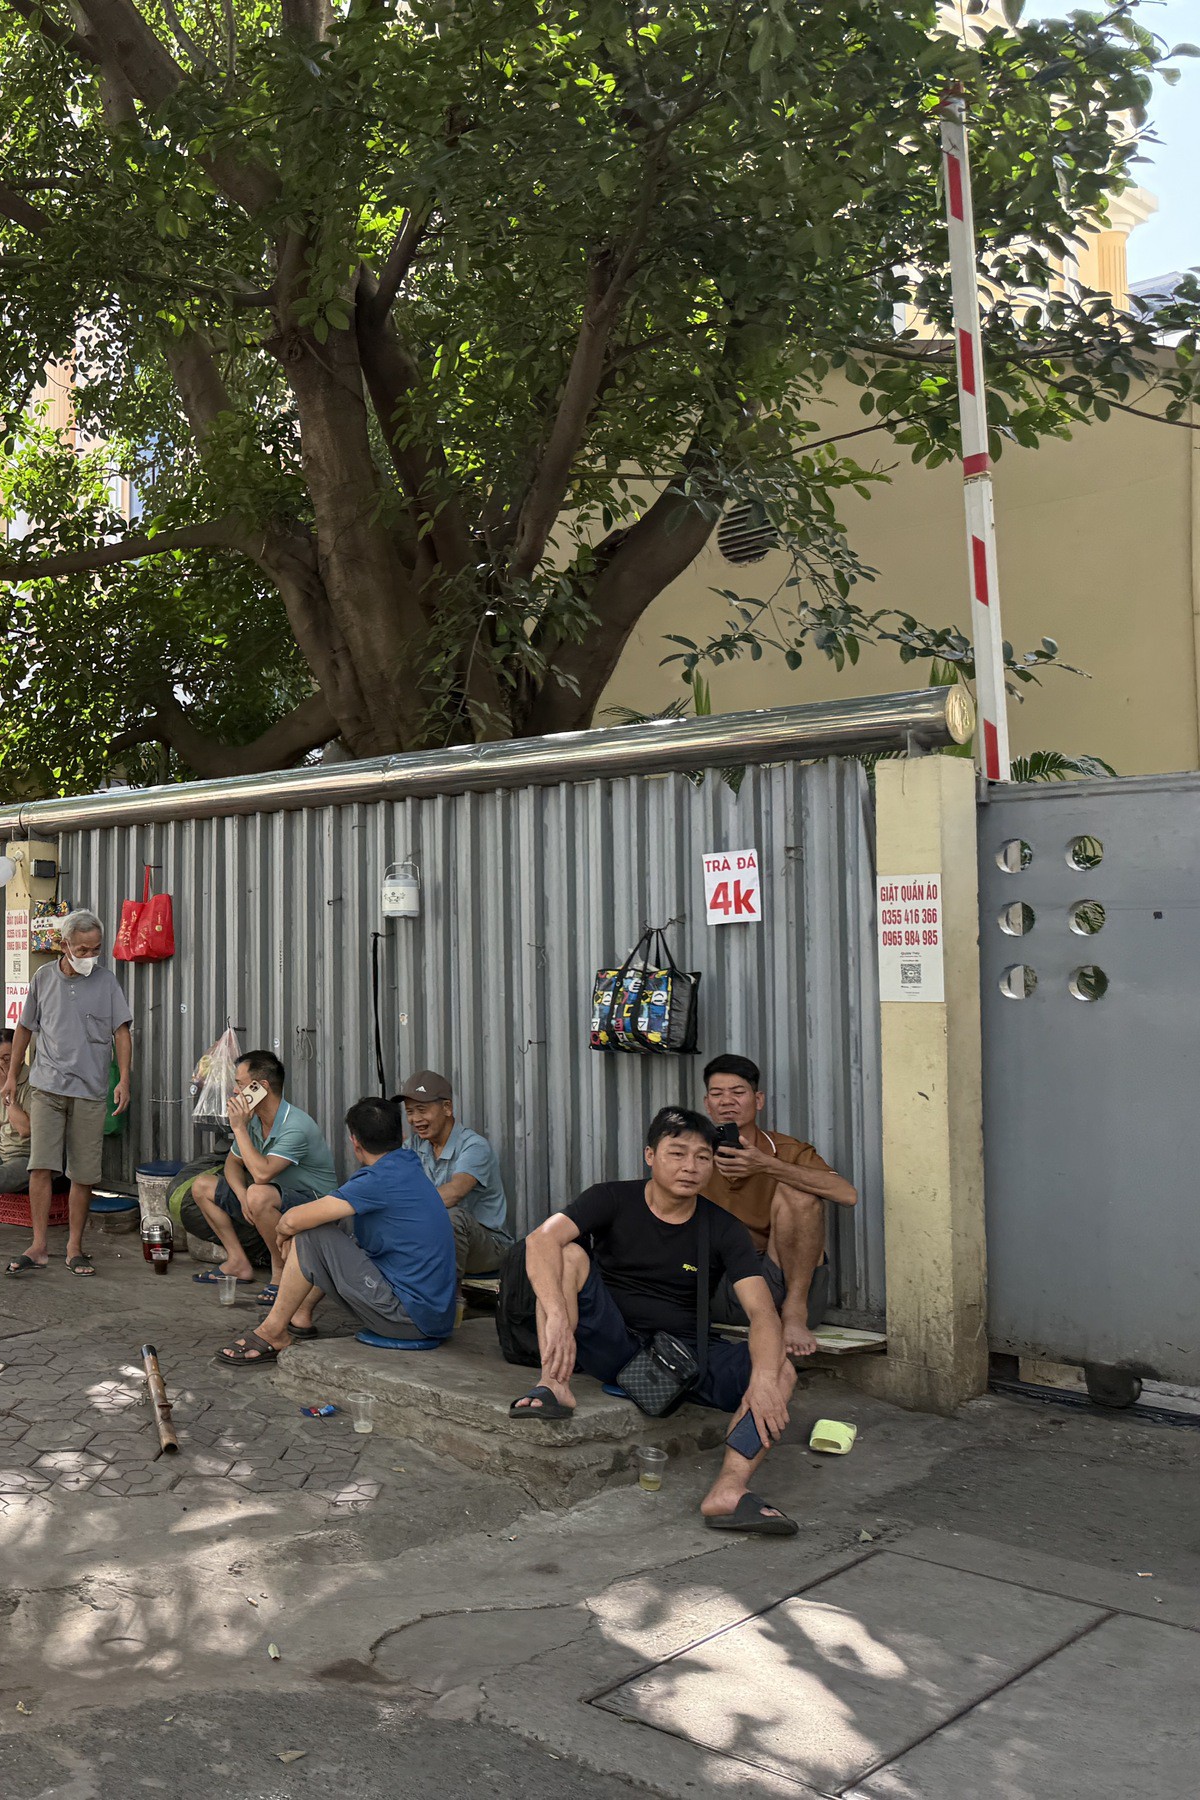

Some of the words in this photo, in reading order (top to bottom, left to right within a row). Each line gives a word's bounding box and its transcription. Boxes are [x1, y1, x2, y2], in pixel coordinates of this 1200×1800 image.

[705, 855, 731, 873] TRÀ
[737, 852, 756, 870] ĐÁ
[709, 879, 757, 916] 4k
[880, 883, 899, 905] GIẶT
[926, 880, 938, 901] ÁO
[882, 909, 902, 925] 0355
[904, 908, 920, 925] 416
[921, 907, 938, 924] 366
[882, 930, 903, 946] 0965
[904, 930, 921, 946] 984
[922, 929, 938, 946] 985
